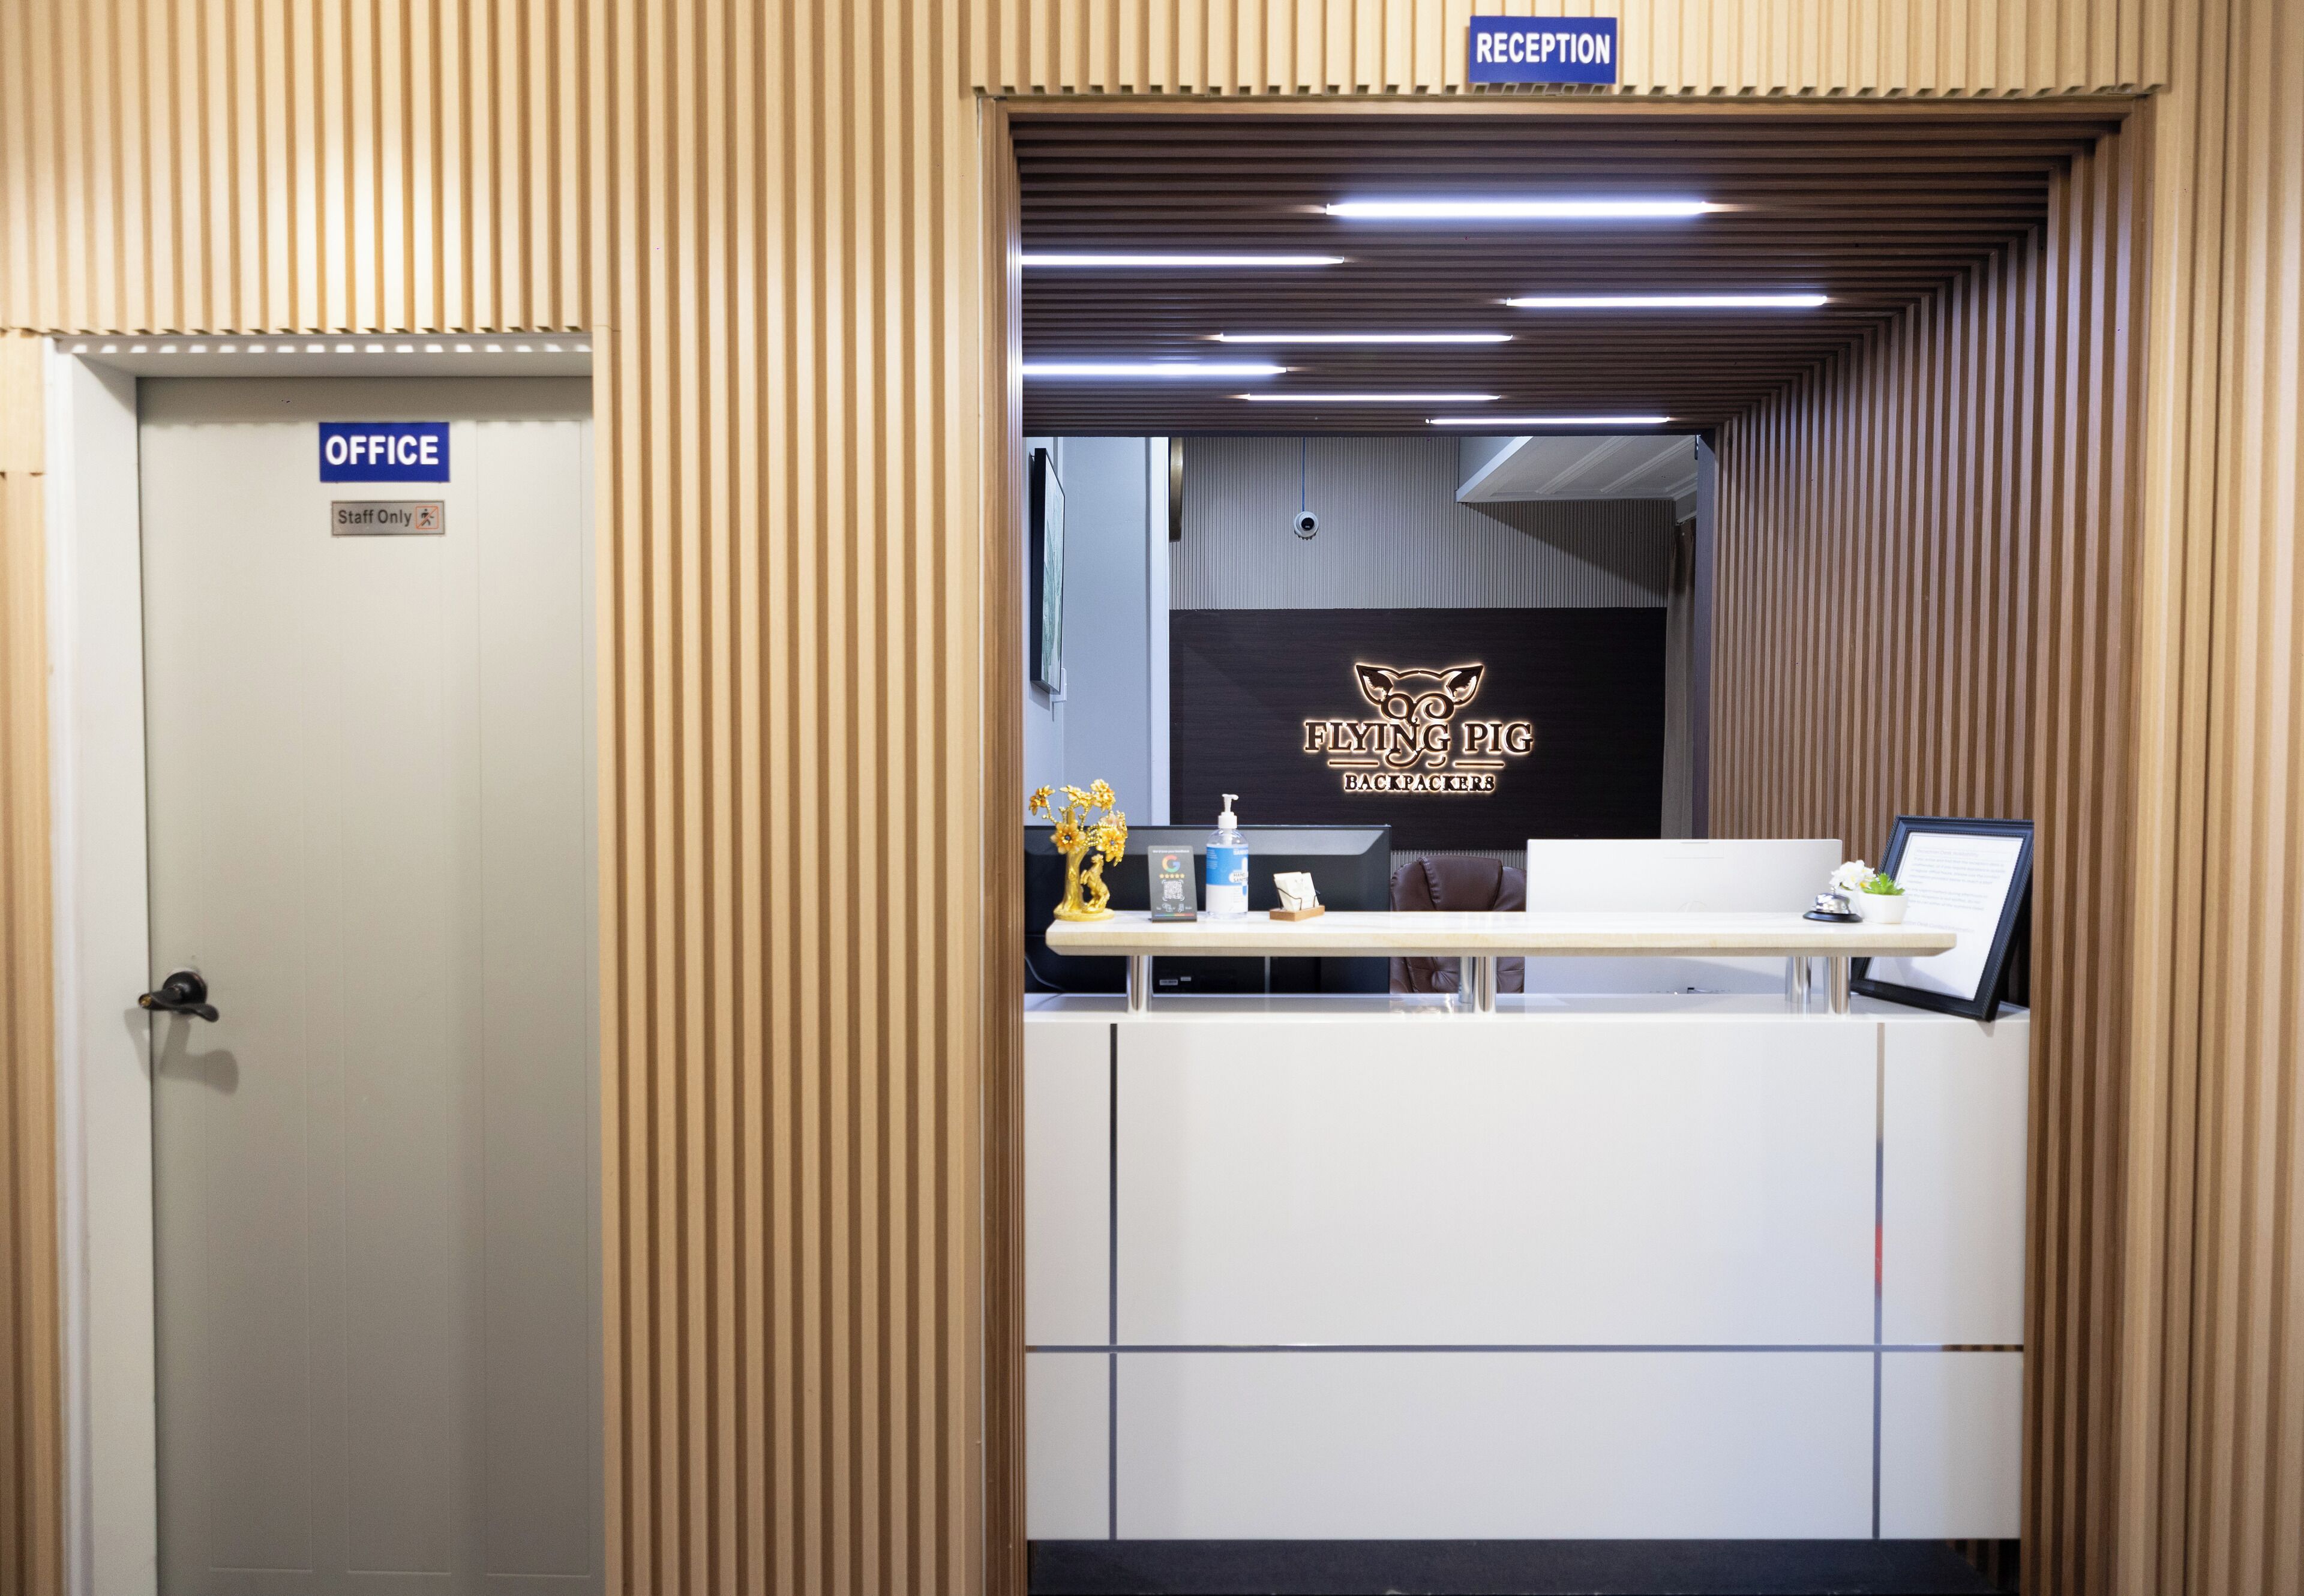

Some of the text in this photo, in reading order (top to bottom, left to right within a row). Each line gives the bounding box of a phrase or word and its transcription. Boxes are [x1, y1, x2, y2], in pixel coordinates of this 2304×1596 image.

[1477, 32, 1610, 64] RECEPTION
[326, 435, 439, 465] OFFICE
[338, 510, 412, 526] Staff Only
[1305, 722, 1534, 754] FLYING PIG
[1345, 774, 1495, 791] BACKPACKERS
